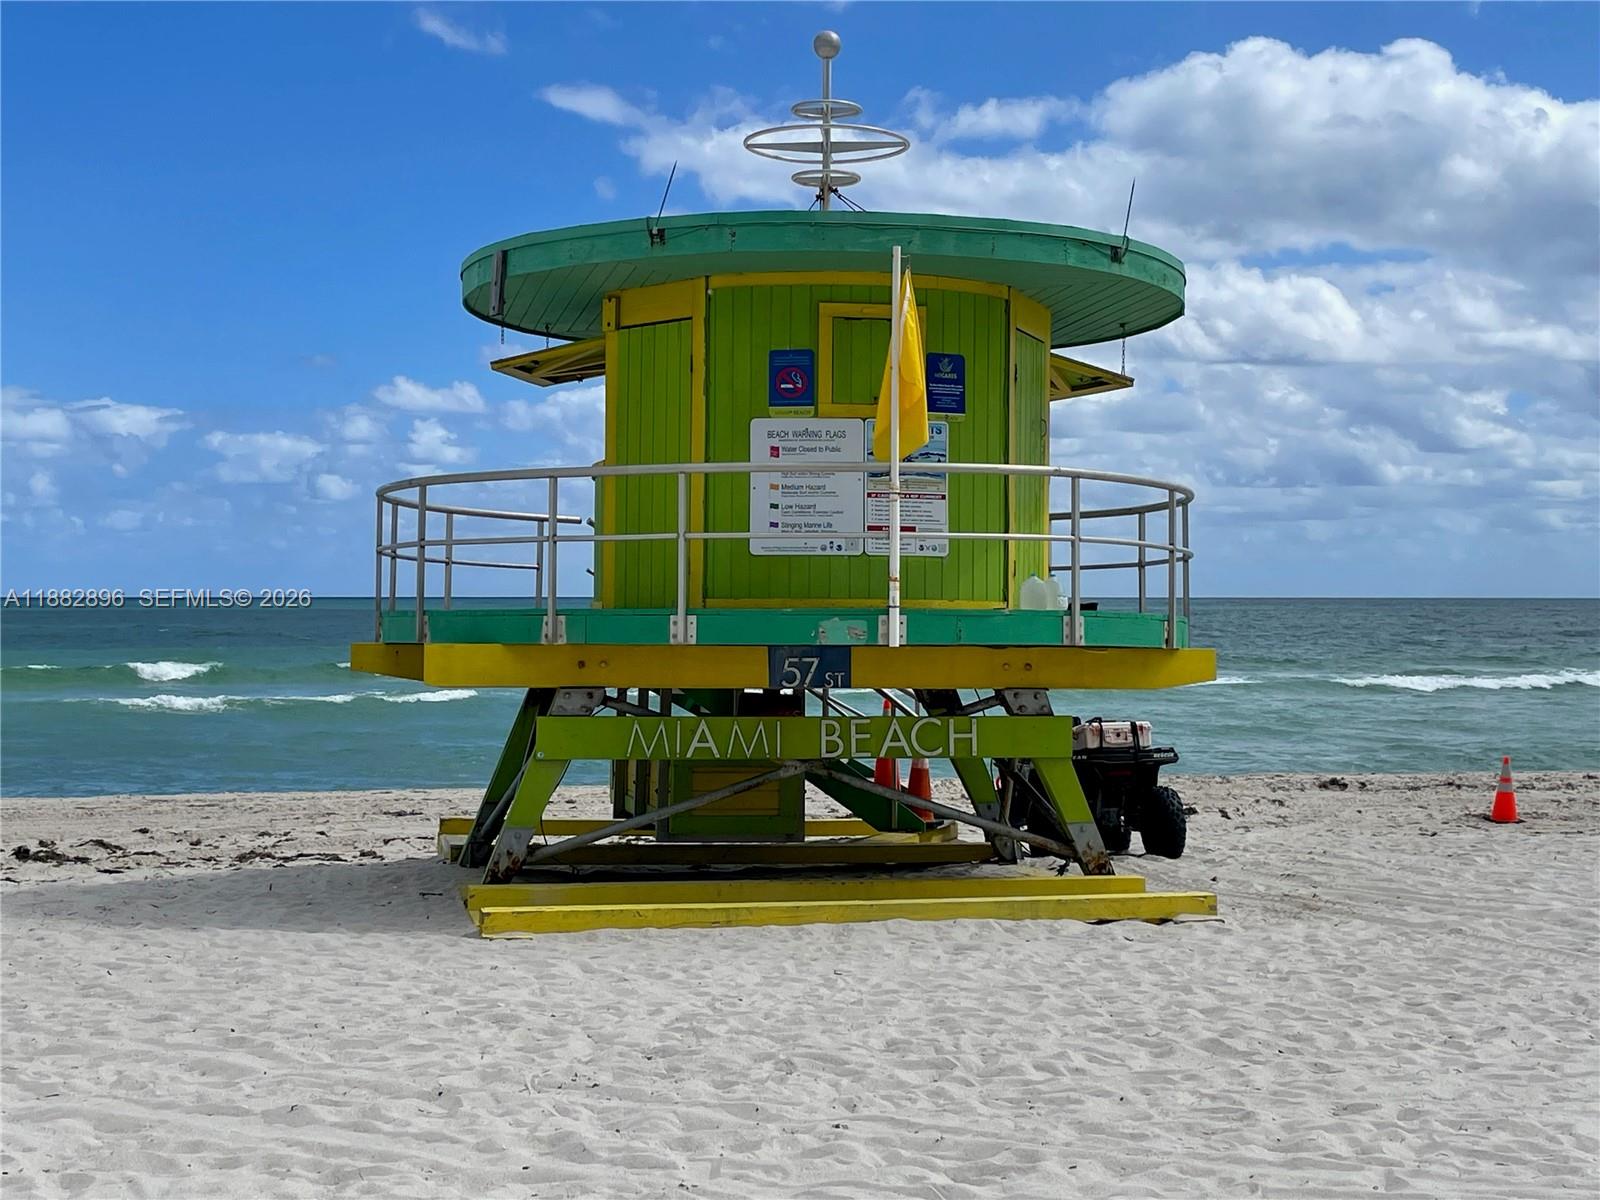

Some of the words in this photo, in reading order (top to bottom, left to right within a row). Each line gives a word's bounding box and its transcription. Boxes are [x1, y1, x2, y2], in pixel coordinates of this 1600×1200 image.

[767, 430, 789, 439] BEACH
[792, 430, 822, 439] WARNING
[825, 430, 847, 439] FLAGS
[781, 657, 820, 688] 57
[824, 672, 845, 688] ST
[626, 719, 782, 758] MIAMI
[820, 717, 978, 758] BEACH
